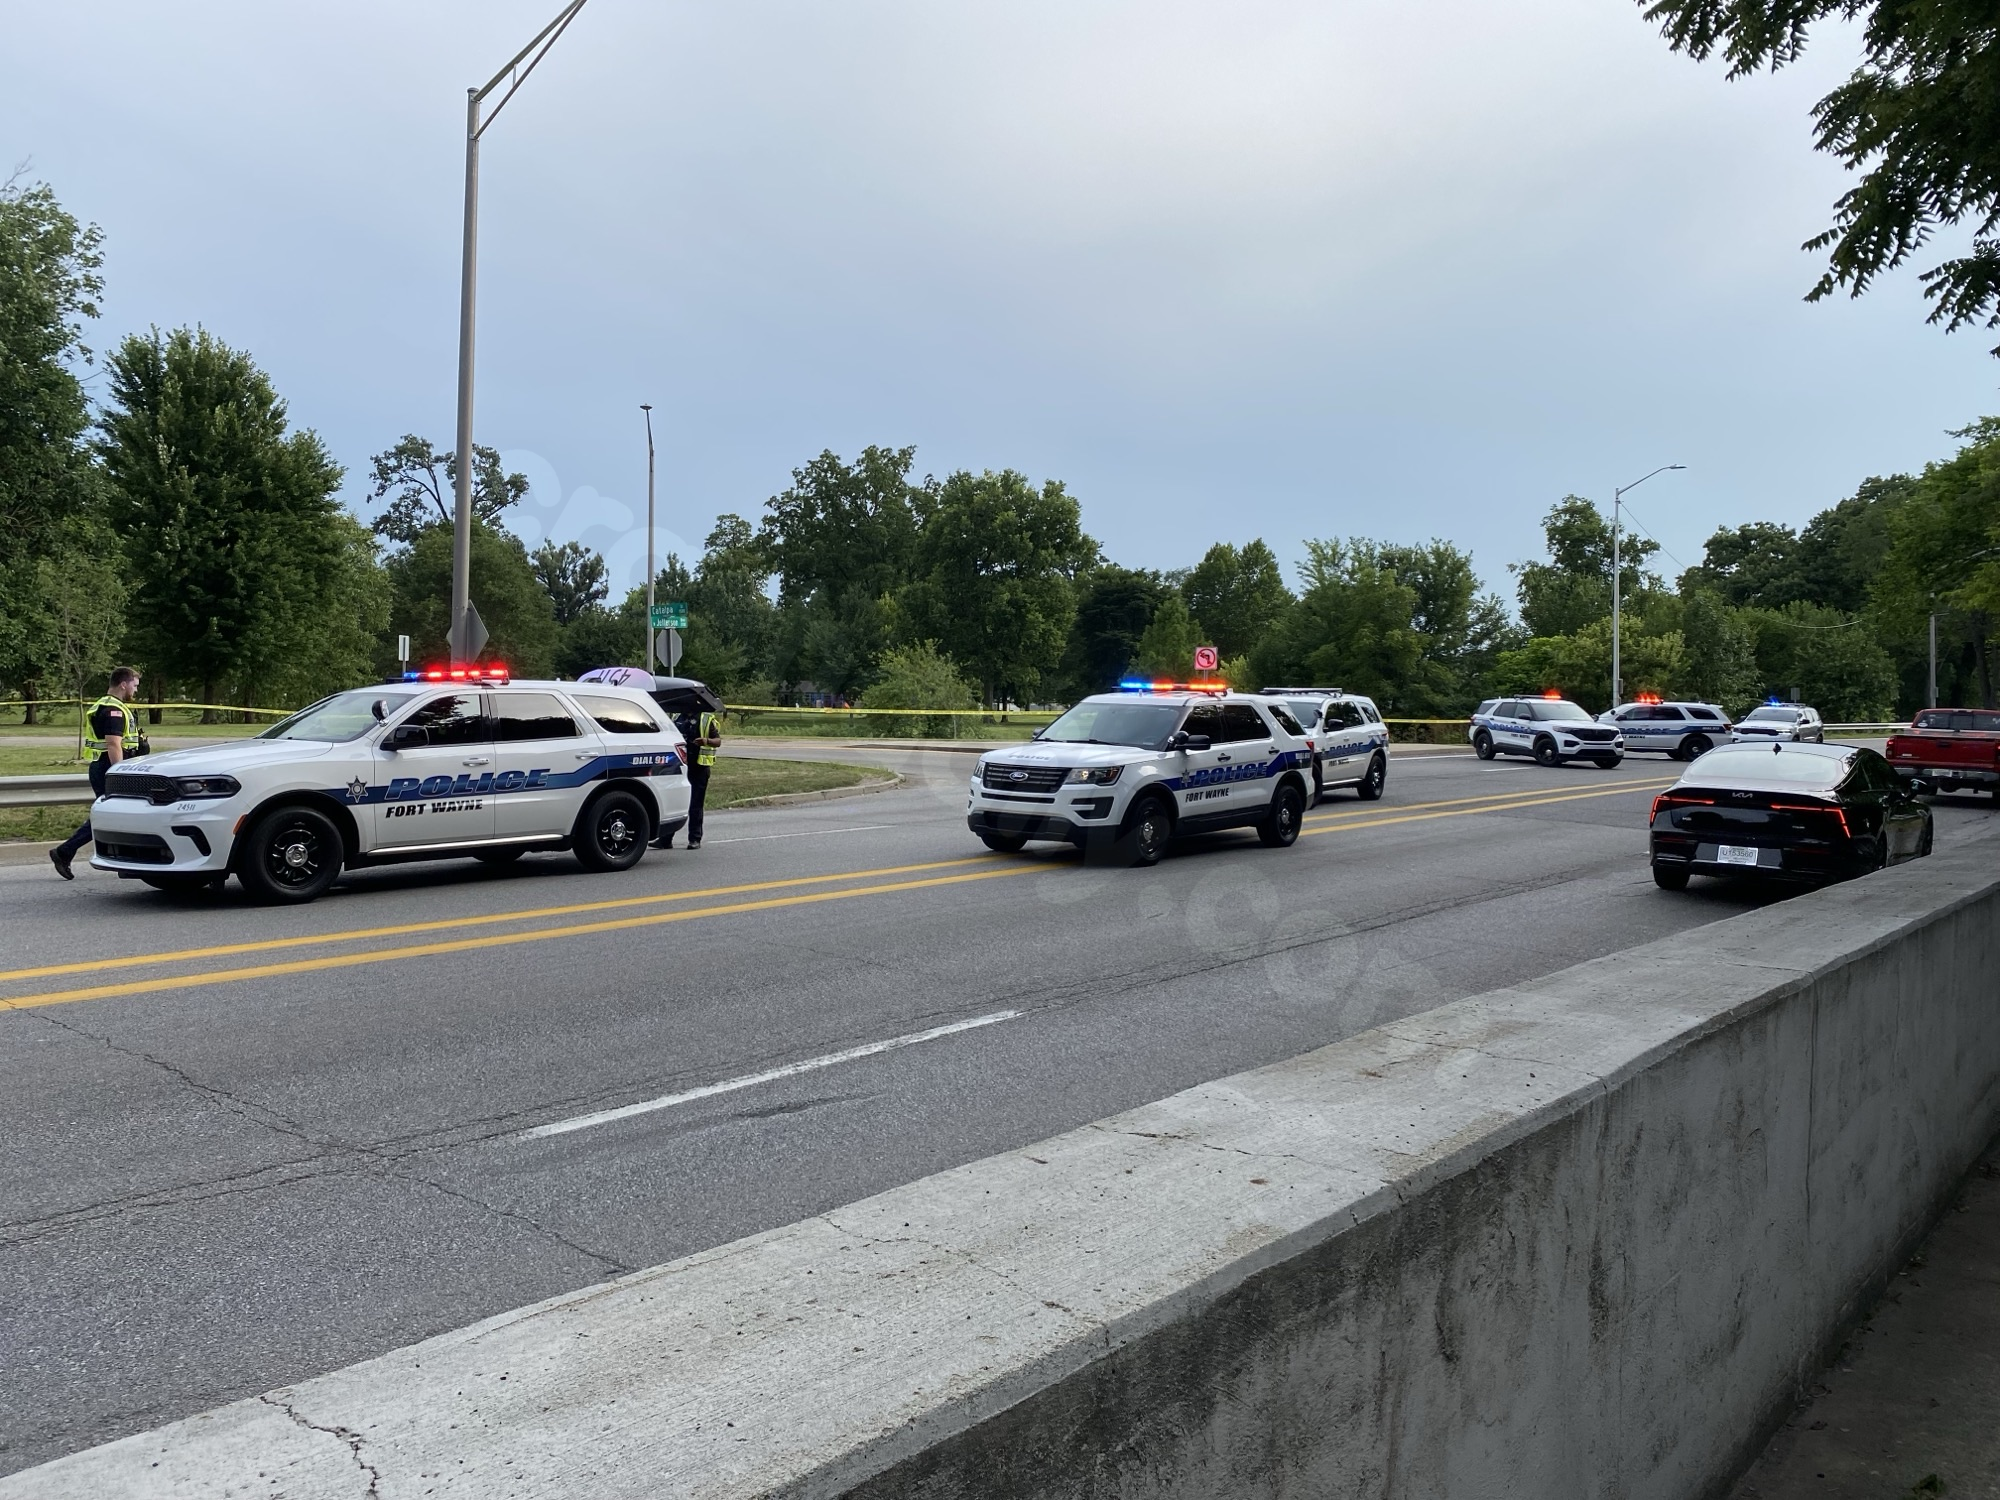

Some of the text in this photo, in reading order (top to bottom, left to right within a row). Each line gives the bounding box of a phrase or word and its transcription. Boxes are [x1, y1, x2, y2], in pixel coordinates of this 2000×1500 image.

[652, 605, 674, 615] Catalpa
[116, 764, 154, 772] POLICE
[632, 755, 670, 765] DIAL 911
[1193, 762, 1269, 787] POLICE
[384, 768, 552, 801] POLICE
[1184, 787, 1230, 803] FORT WAYNE
[385, 799, 484, 819] FORT WAYNE
